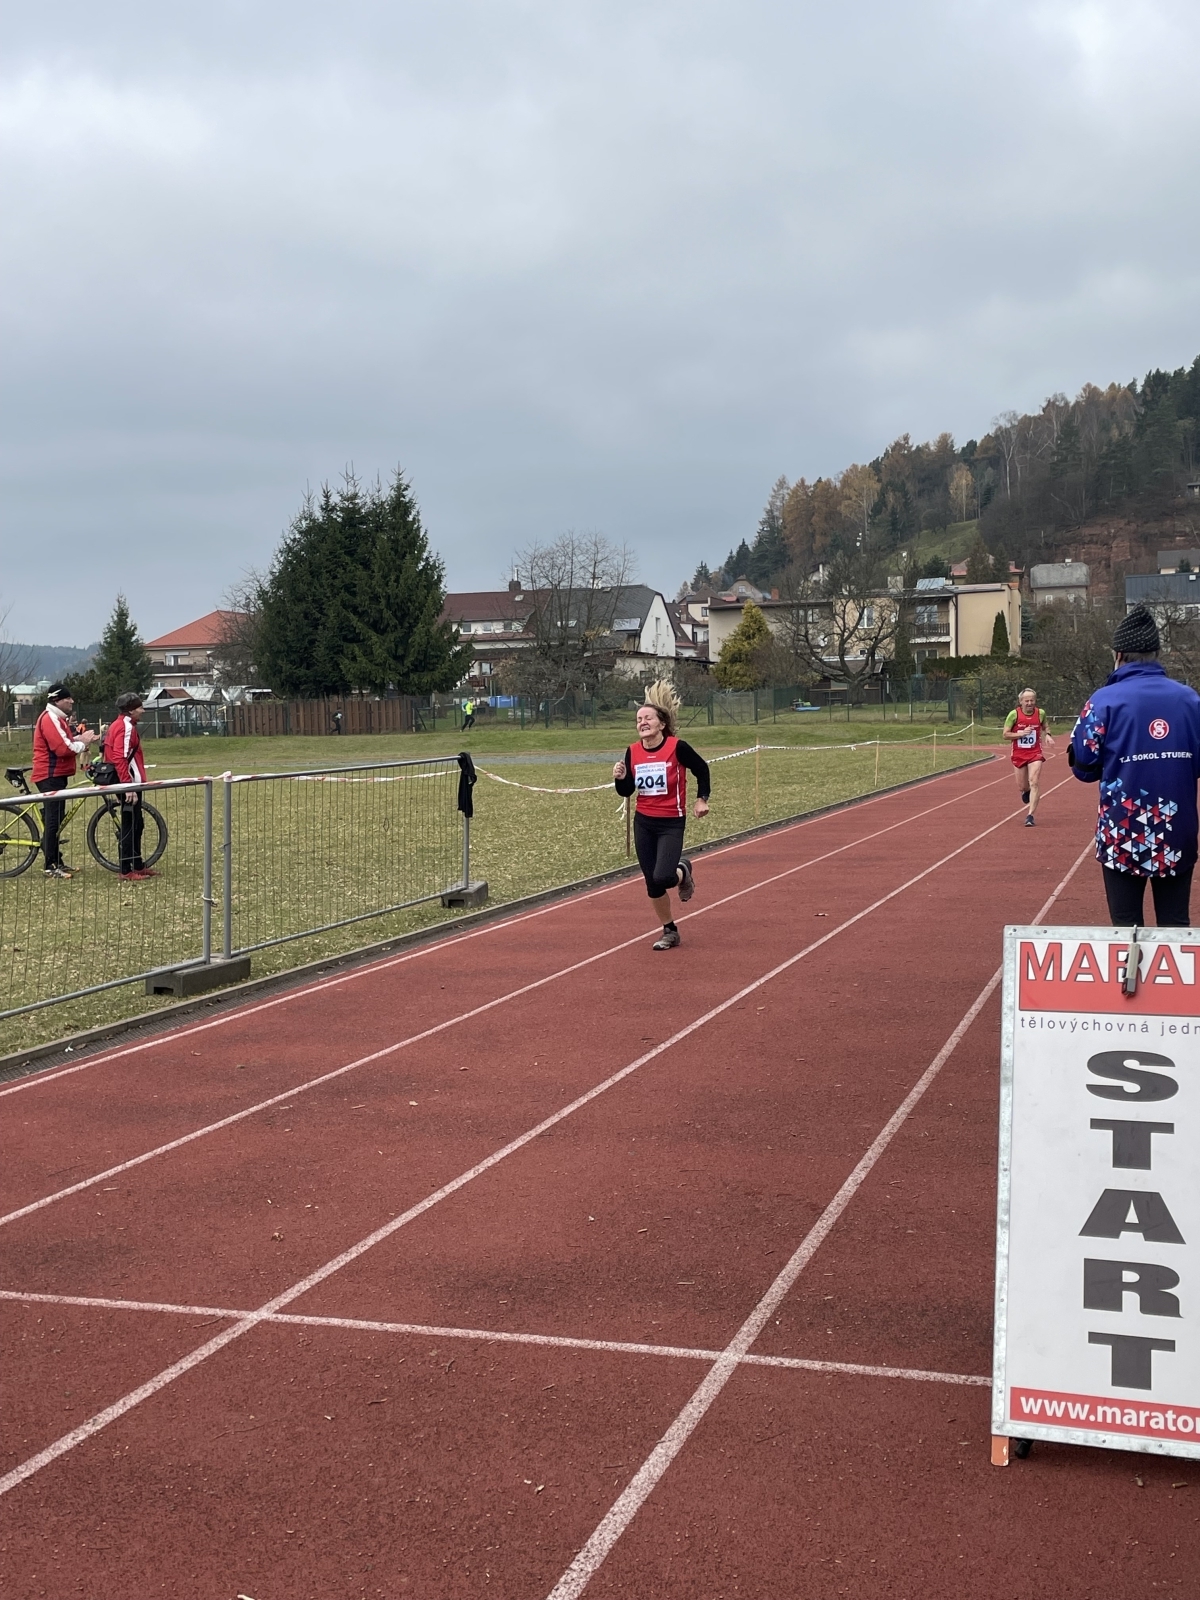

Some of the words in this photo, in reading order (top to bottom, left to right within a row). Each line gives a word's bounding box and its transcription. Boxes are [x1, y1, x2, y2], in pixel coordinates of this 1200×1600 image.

[1132, 752, 1159, 761] SOKOL
[637, 775, 665, 789] 204
[1021, 1016, 1150, 1033] tělovýchovná
[1078, 1050, 1187, 1391] START
[1020, 1396, 1200, 1434] www.marato
